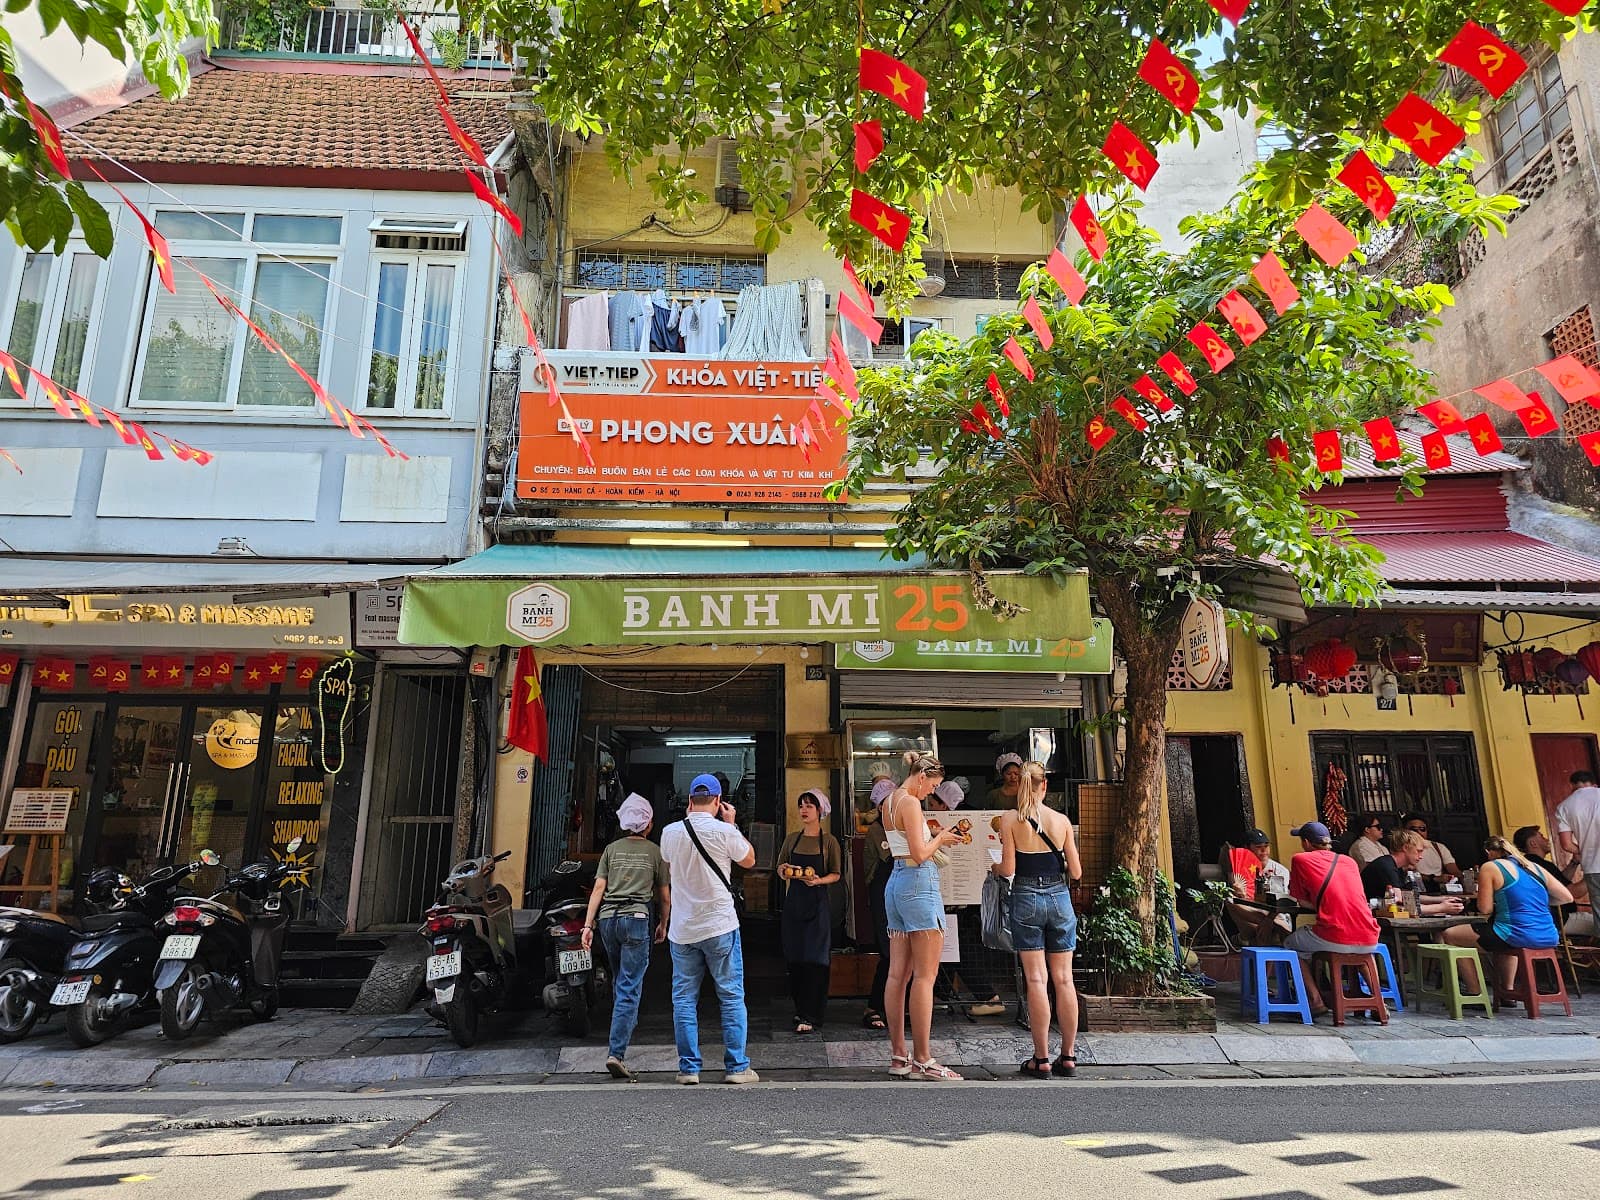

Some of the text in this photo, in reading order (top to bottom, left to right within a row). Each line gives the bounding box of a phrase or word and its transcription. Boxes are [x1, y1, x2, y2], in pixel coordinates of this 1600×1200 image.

[667, 363, 728, 386] KHÓA
[601, 413, 810, 445] PHONG XUÂN
[534, 465, 573, 475] CHUYÊN:
[601, 465, 627, 475] BUÔN
[632, 466, 652, 476] BÁN
[672, 468, 691, 477] CÁC
[695, 469, 716, 478] LOẠI
[720, 468, 745, 478] KHÓA
[748, 469, 759, 478] VÀ
[798, 471, 814, 479] KIM
[818, 469, 833, 479] KHÍ
[605, 487, 623, 495] HOÀN
[178, 603, 197, 624] &
[200, 604, 315, 626] MASSAGE
[522, 607, 553, 615] BANH
[622, 593, 780, 628] BANH
[807, 592, 880, 626] MI
[892, 585, 969, 631] 25
[1008, 637, 1043, 653] MI
[1190, 631, 1208, 650] BANH
[809, 667, 822, 678] 25
[325, 677, 346, 697] SPA
[1380, 699, 1394, 709] 27
[55, 705, 81, 739] GỘI
[46, 740, 77, 772] ĐẦU
[277, 744, 309, 767] FACIAL
[278, 781, 324, 805] RELAXING
[273, 820, 319, 844] SHAMPOO
